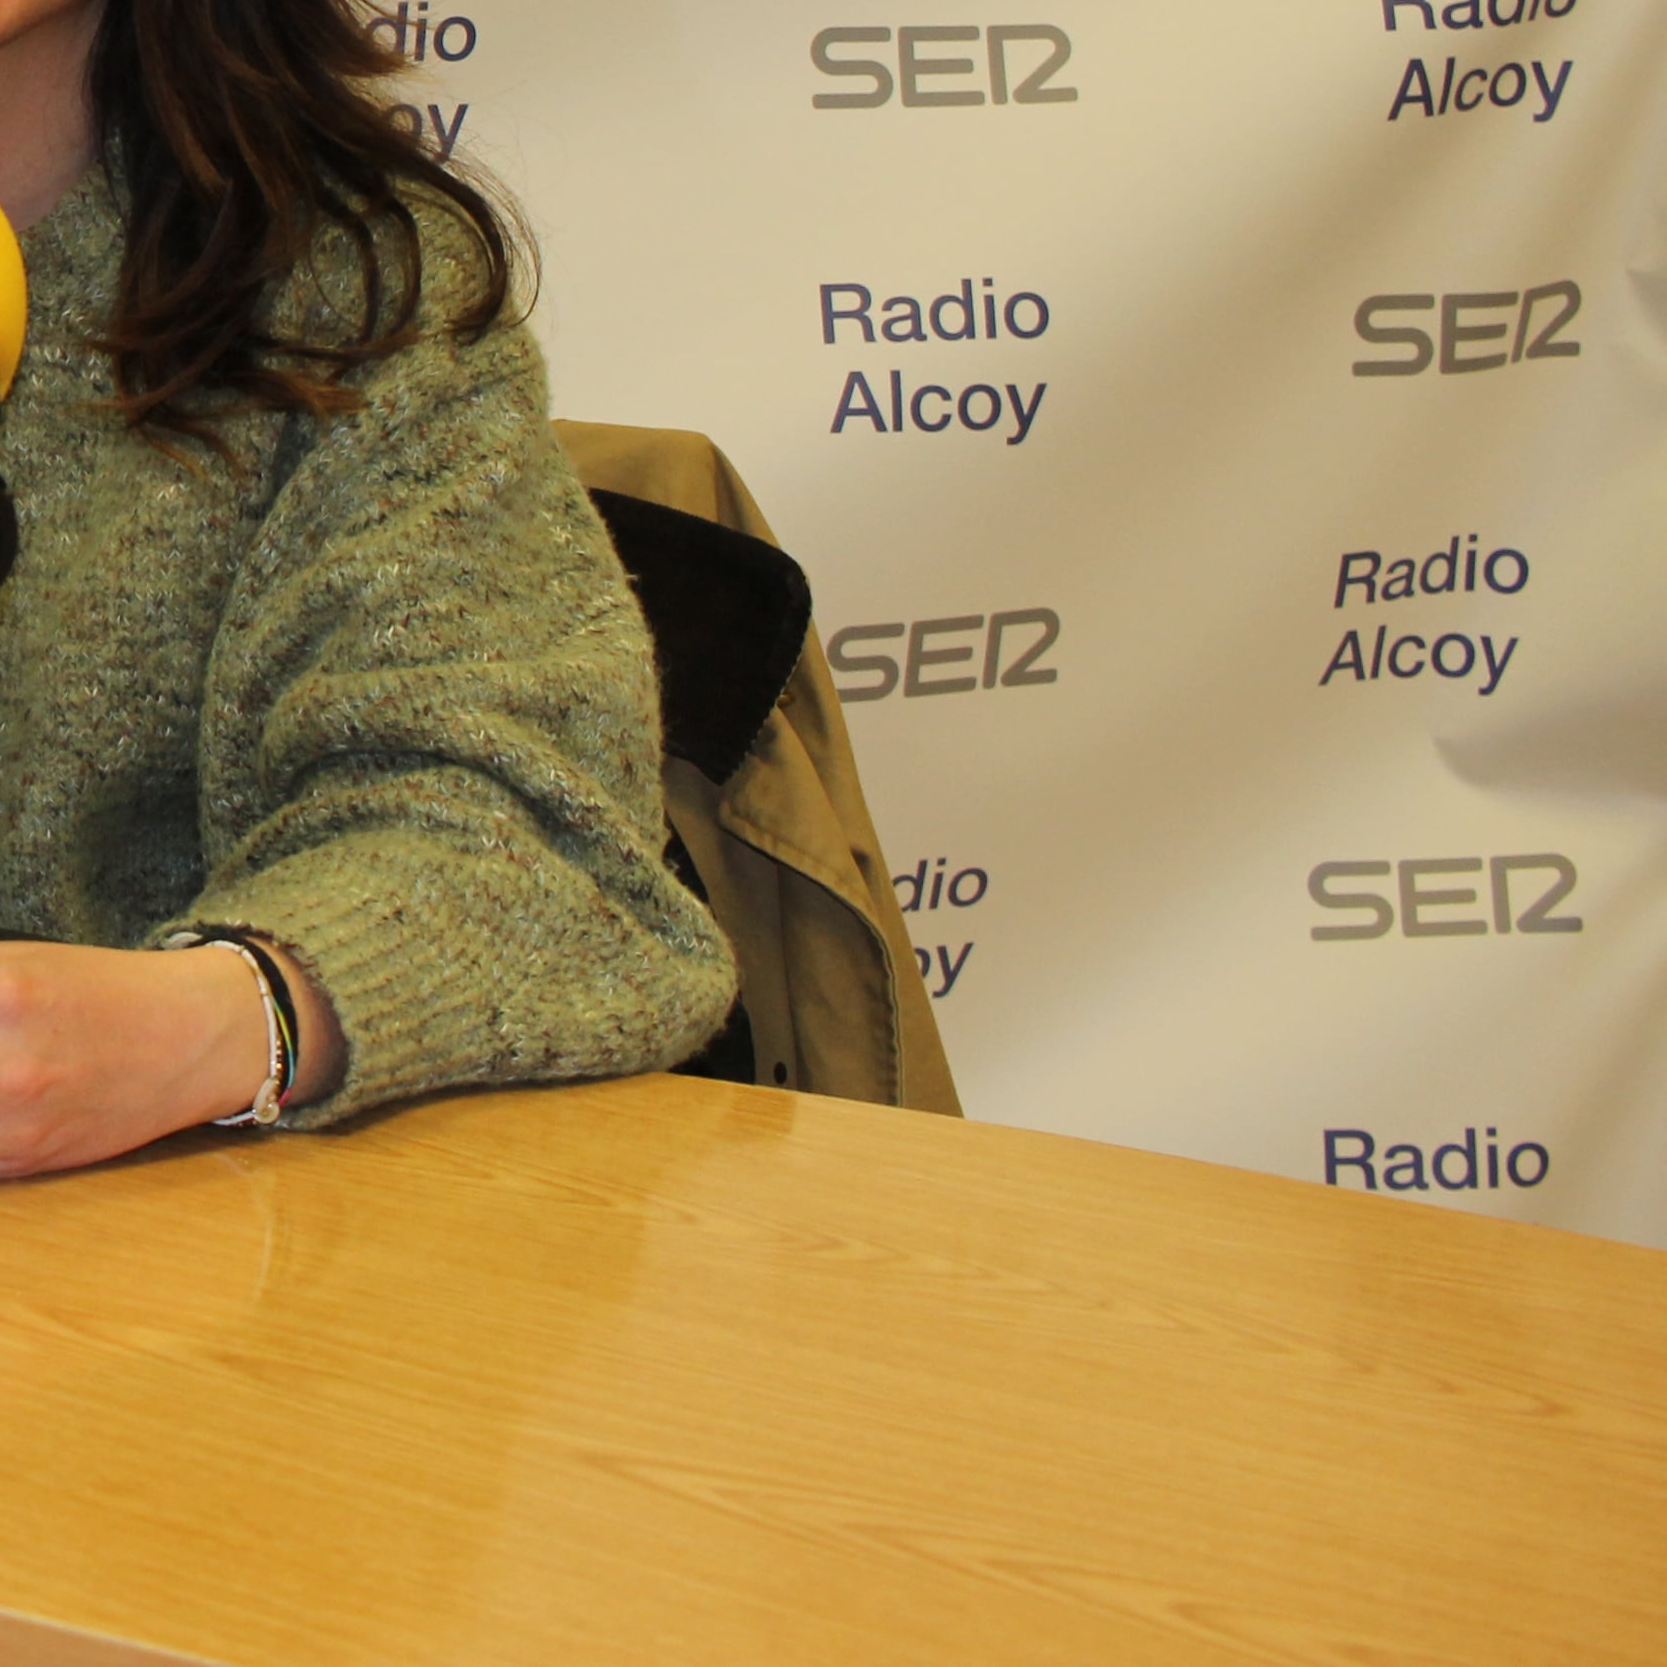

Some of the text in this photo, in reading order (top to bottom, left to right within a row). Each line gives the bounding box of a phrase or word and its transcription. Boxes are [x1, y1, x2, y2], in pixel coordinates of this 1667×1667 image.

[367, 2, 477, 62] dio
[811, 24, 1078, 109] SER
[1387, 56, 1573, 123] Alcoy
[819, 277, 1050, 345] Radio
[1352, 279, 1582, 377] SER
[830, 369, 1047, 446] Alcoy
[1334, 533, 1529, 609] Radio
[826, 607, 1060, 704] SER
[1318, 624, 1519, 696] Alcoy
[891, 857, 988, 913] dio
[1308, 853, 1583, 941] SER
[1323, 1127, 1550, 1192] Radio
